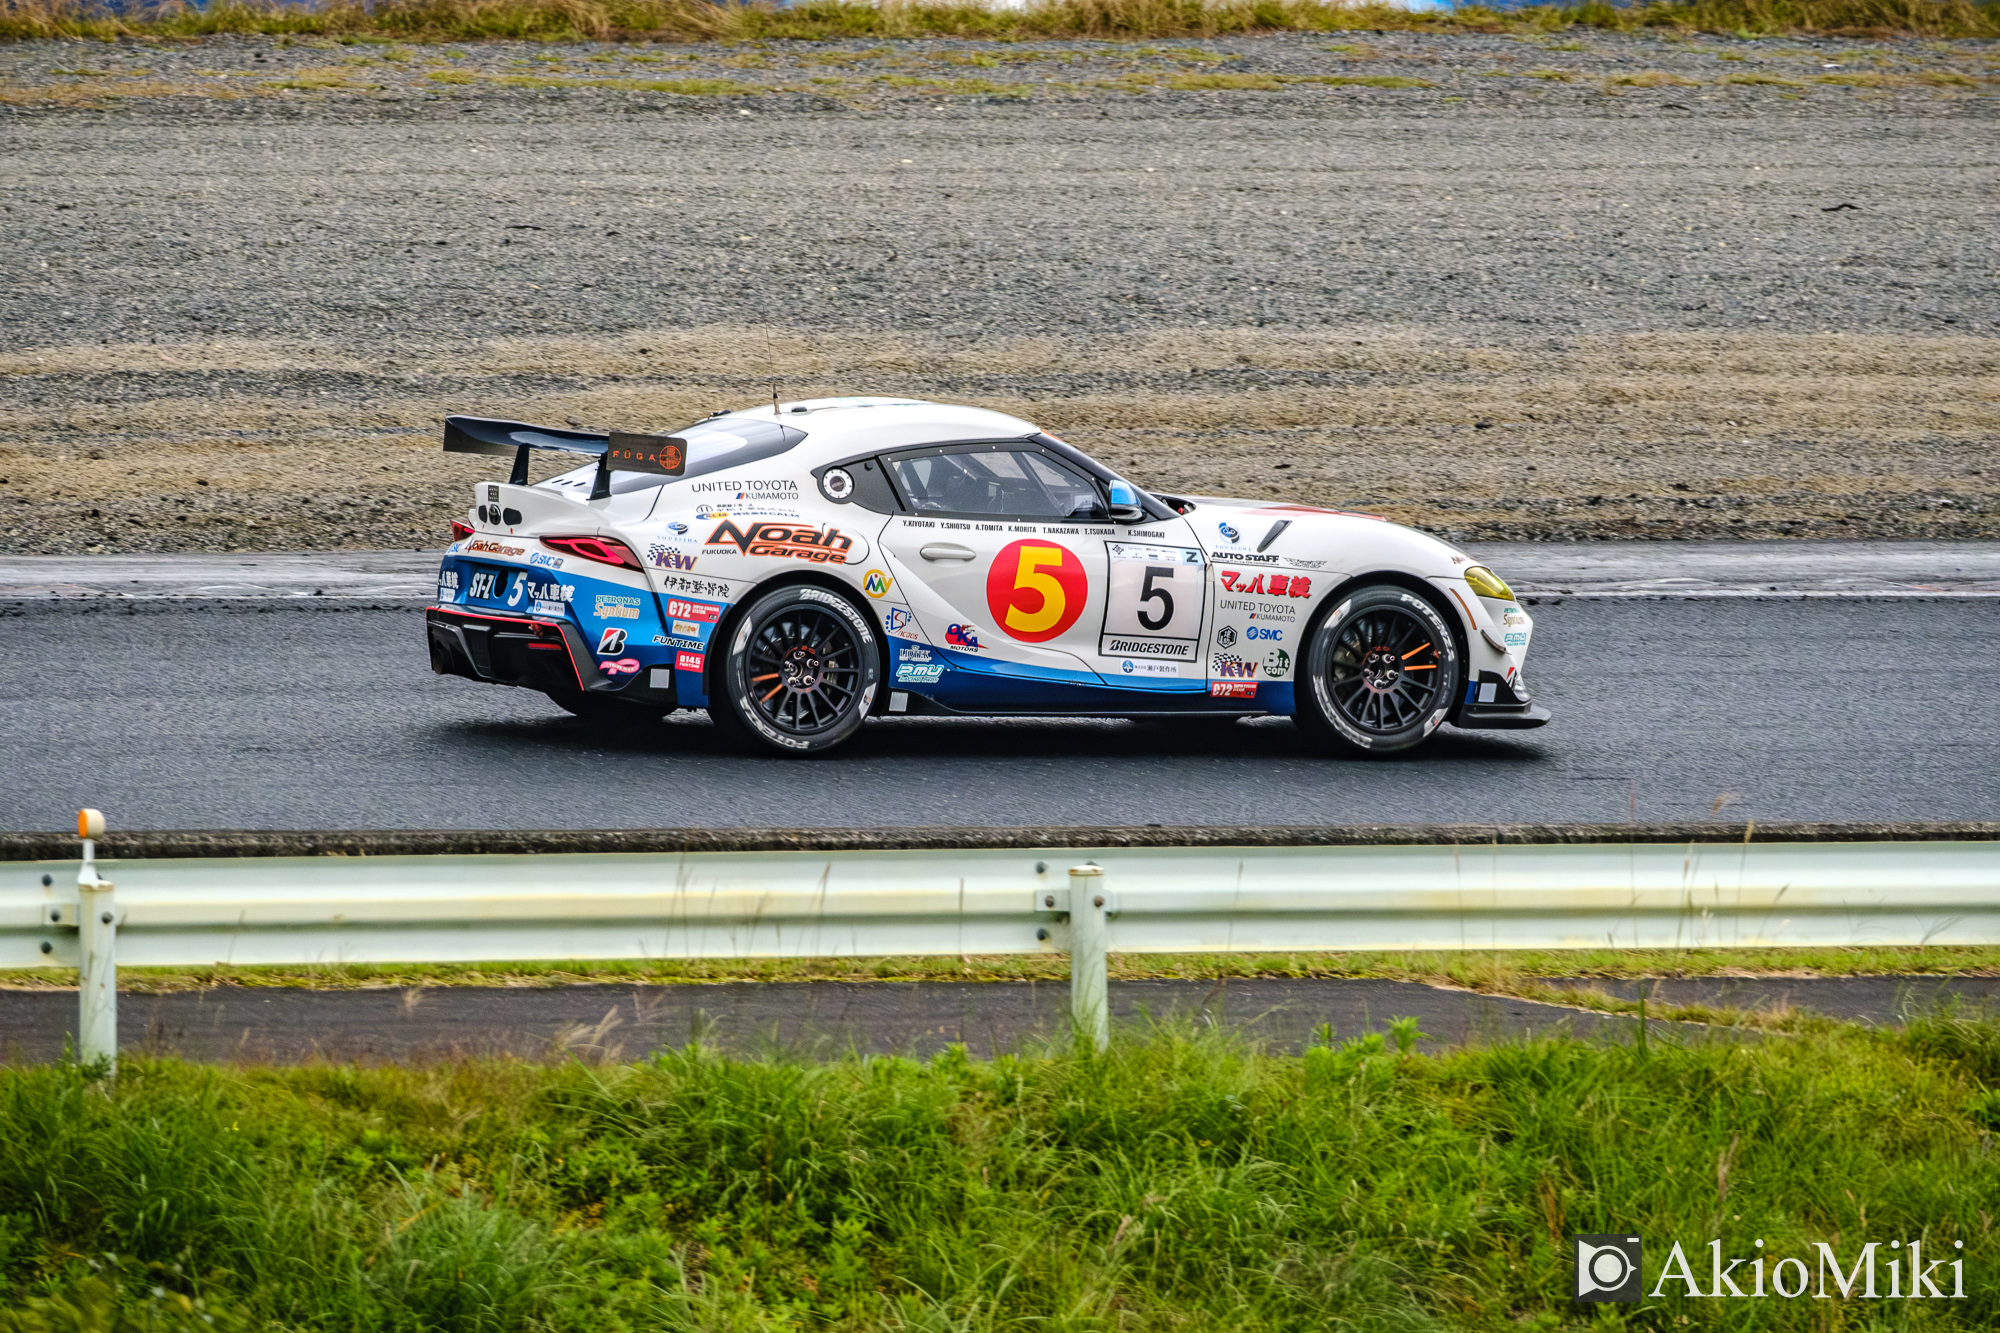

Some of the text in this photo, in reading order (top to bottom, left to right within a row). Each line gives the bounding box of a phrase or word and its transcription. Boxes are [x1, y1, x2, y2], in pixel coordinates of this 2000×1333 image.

[691, 480, 798, 492] UNITED TOYOTA
[745, 492, 799, 500] KUMAMOTO
[902, 519, 936, 528] Y.KIYOTAKI
[940, 522, 971, 530] Y.SHIOTSU
[975, 523, 1004, 532] A.TOMITA
[1008, 525, 1037, 533] K.MORITA
[1042, 526, 1079, 535] T.NAKAZAWA
[1127, 529, 1165, 538] K.SHIMOGAKI
[705, 519, 854, 556] Noah
[537, 555, 555, 567] SMC
[655, 551, 698, 571] KW
[749, 544, 846, 564] Garage
[1186, 552, 1198, 563] Z
[1211, 551, 1244, 560] AUTO
[1245, 554, 1279, 563] STAFF
[469, 572, 495, 599] ST-Z
[507, 571, 528, 607] 5
[1004, 545, 1066, 632] 5
[595, 595, 641, 606] PETRONAS
[1137, 566, 1174, 631] 5
[593, 603, 640, 619] Syntium
[668, 601, 692, 618] C72
[1220, 600, 1296, 615] UNITED TOYOTA
[799, 588, 873, 644] BRIDGESTONE
[1256, 614, 1296, 623] KUMAMOTO
[947, 624, 979, 647] OKA
[1259, 628, 1283, 641] SMC
[1401, 594, 1455, 662] POTENZA
[652, 636, 705, 651] FUNTIME
[950, 645, 979, 653] MOTORS
[1109, 640, 1189, 655] BRIDGESTONE
[1220, 661, 1258, 678] KW
[1212, 683, 1232, 696] C72
